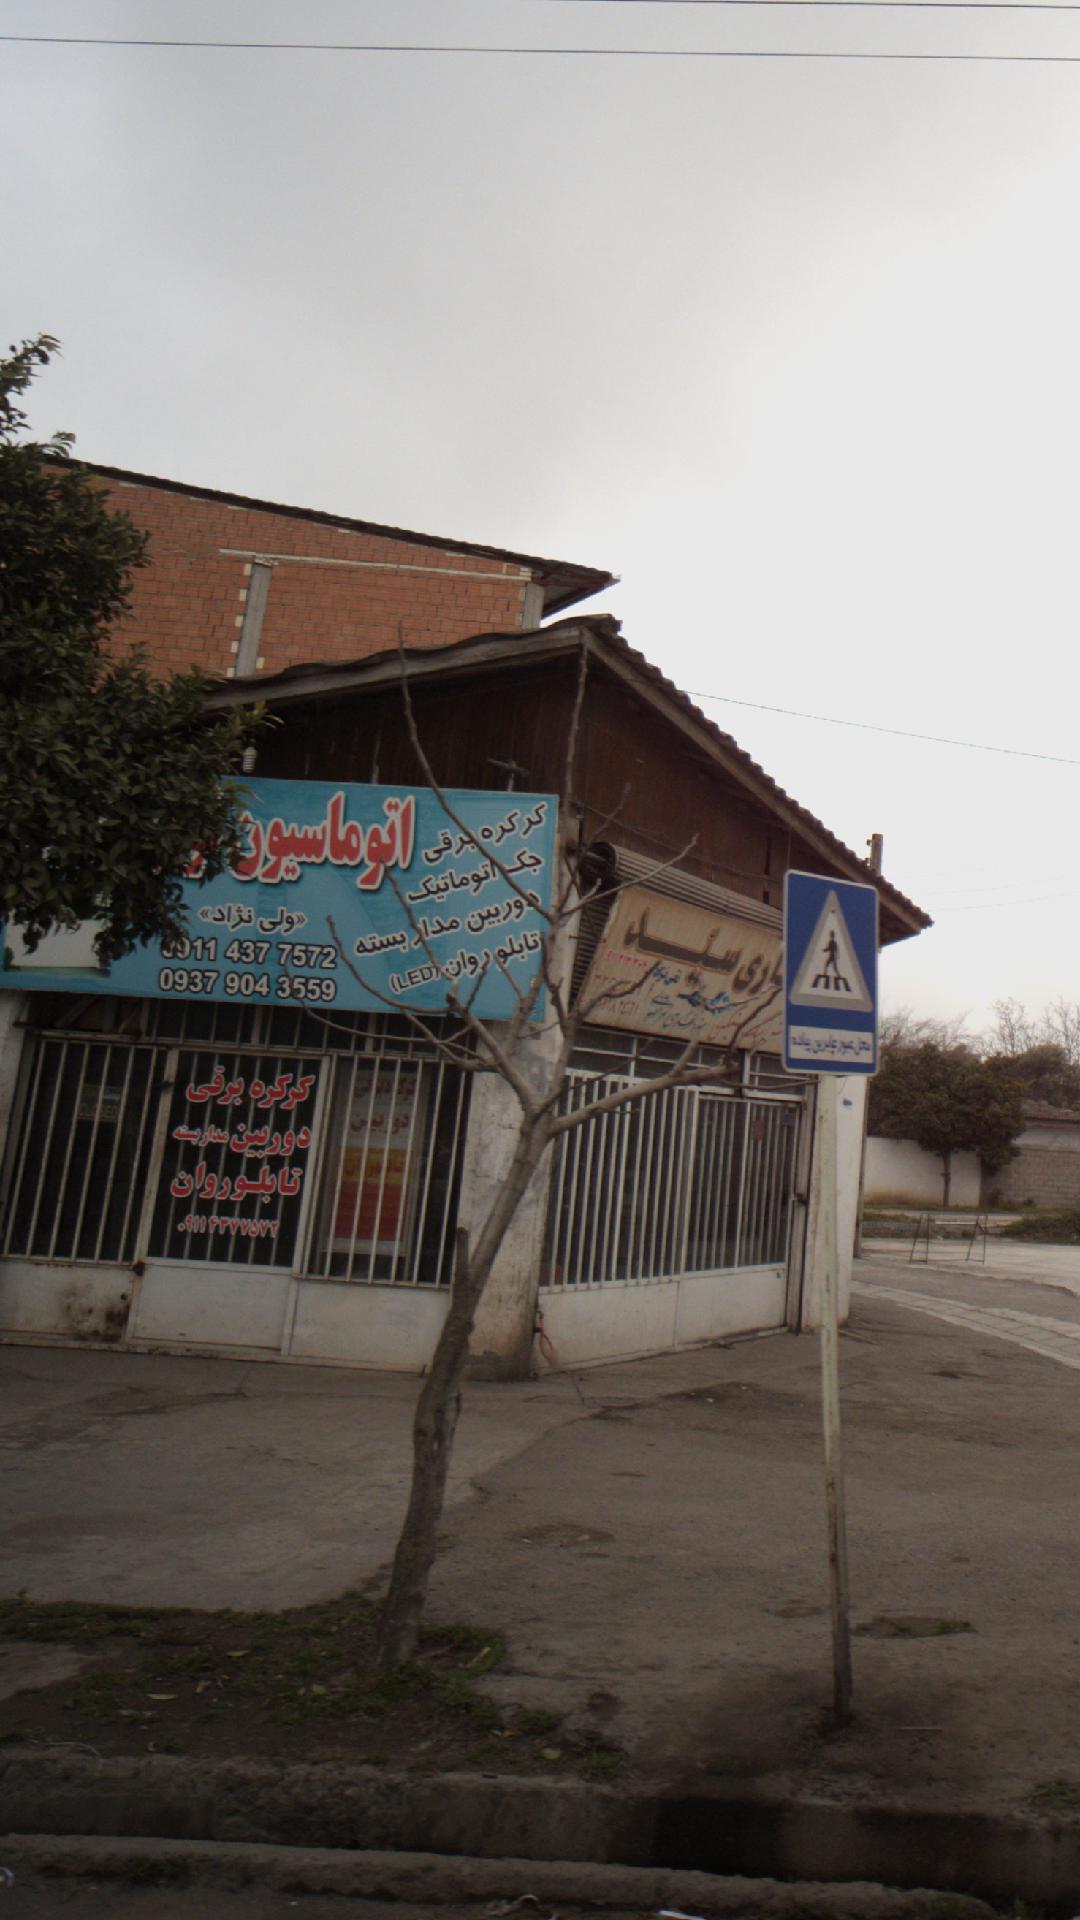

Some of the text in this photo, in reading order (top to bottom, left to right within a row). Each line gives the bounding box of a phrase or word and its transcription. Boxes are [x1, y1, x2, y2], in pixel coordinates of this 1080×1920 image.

[424, 803, 547, 864] کرکره برقی
[407, 849, 543, 903] جک اتوماتیک
[353, 892, 540, 957] دوربین مدار بسته
[226, 939, 270, 963] 437
[277, 942, 336, 968] 7572
[445, 950, 491, 978] روان
[496, 932, 541, 967] تابلو
[160, 968, 336, 1001] 0937 904 3559
[186, 1065, 245, 1106] برقی
[250, 1072, 316, 1109] کرکره
[230, 1122, 312, 1159] دوربین
